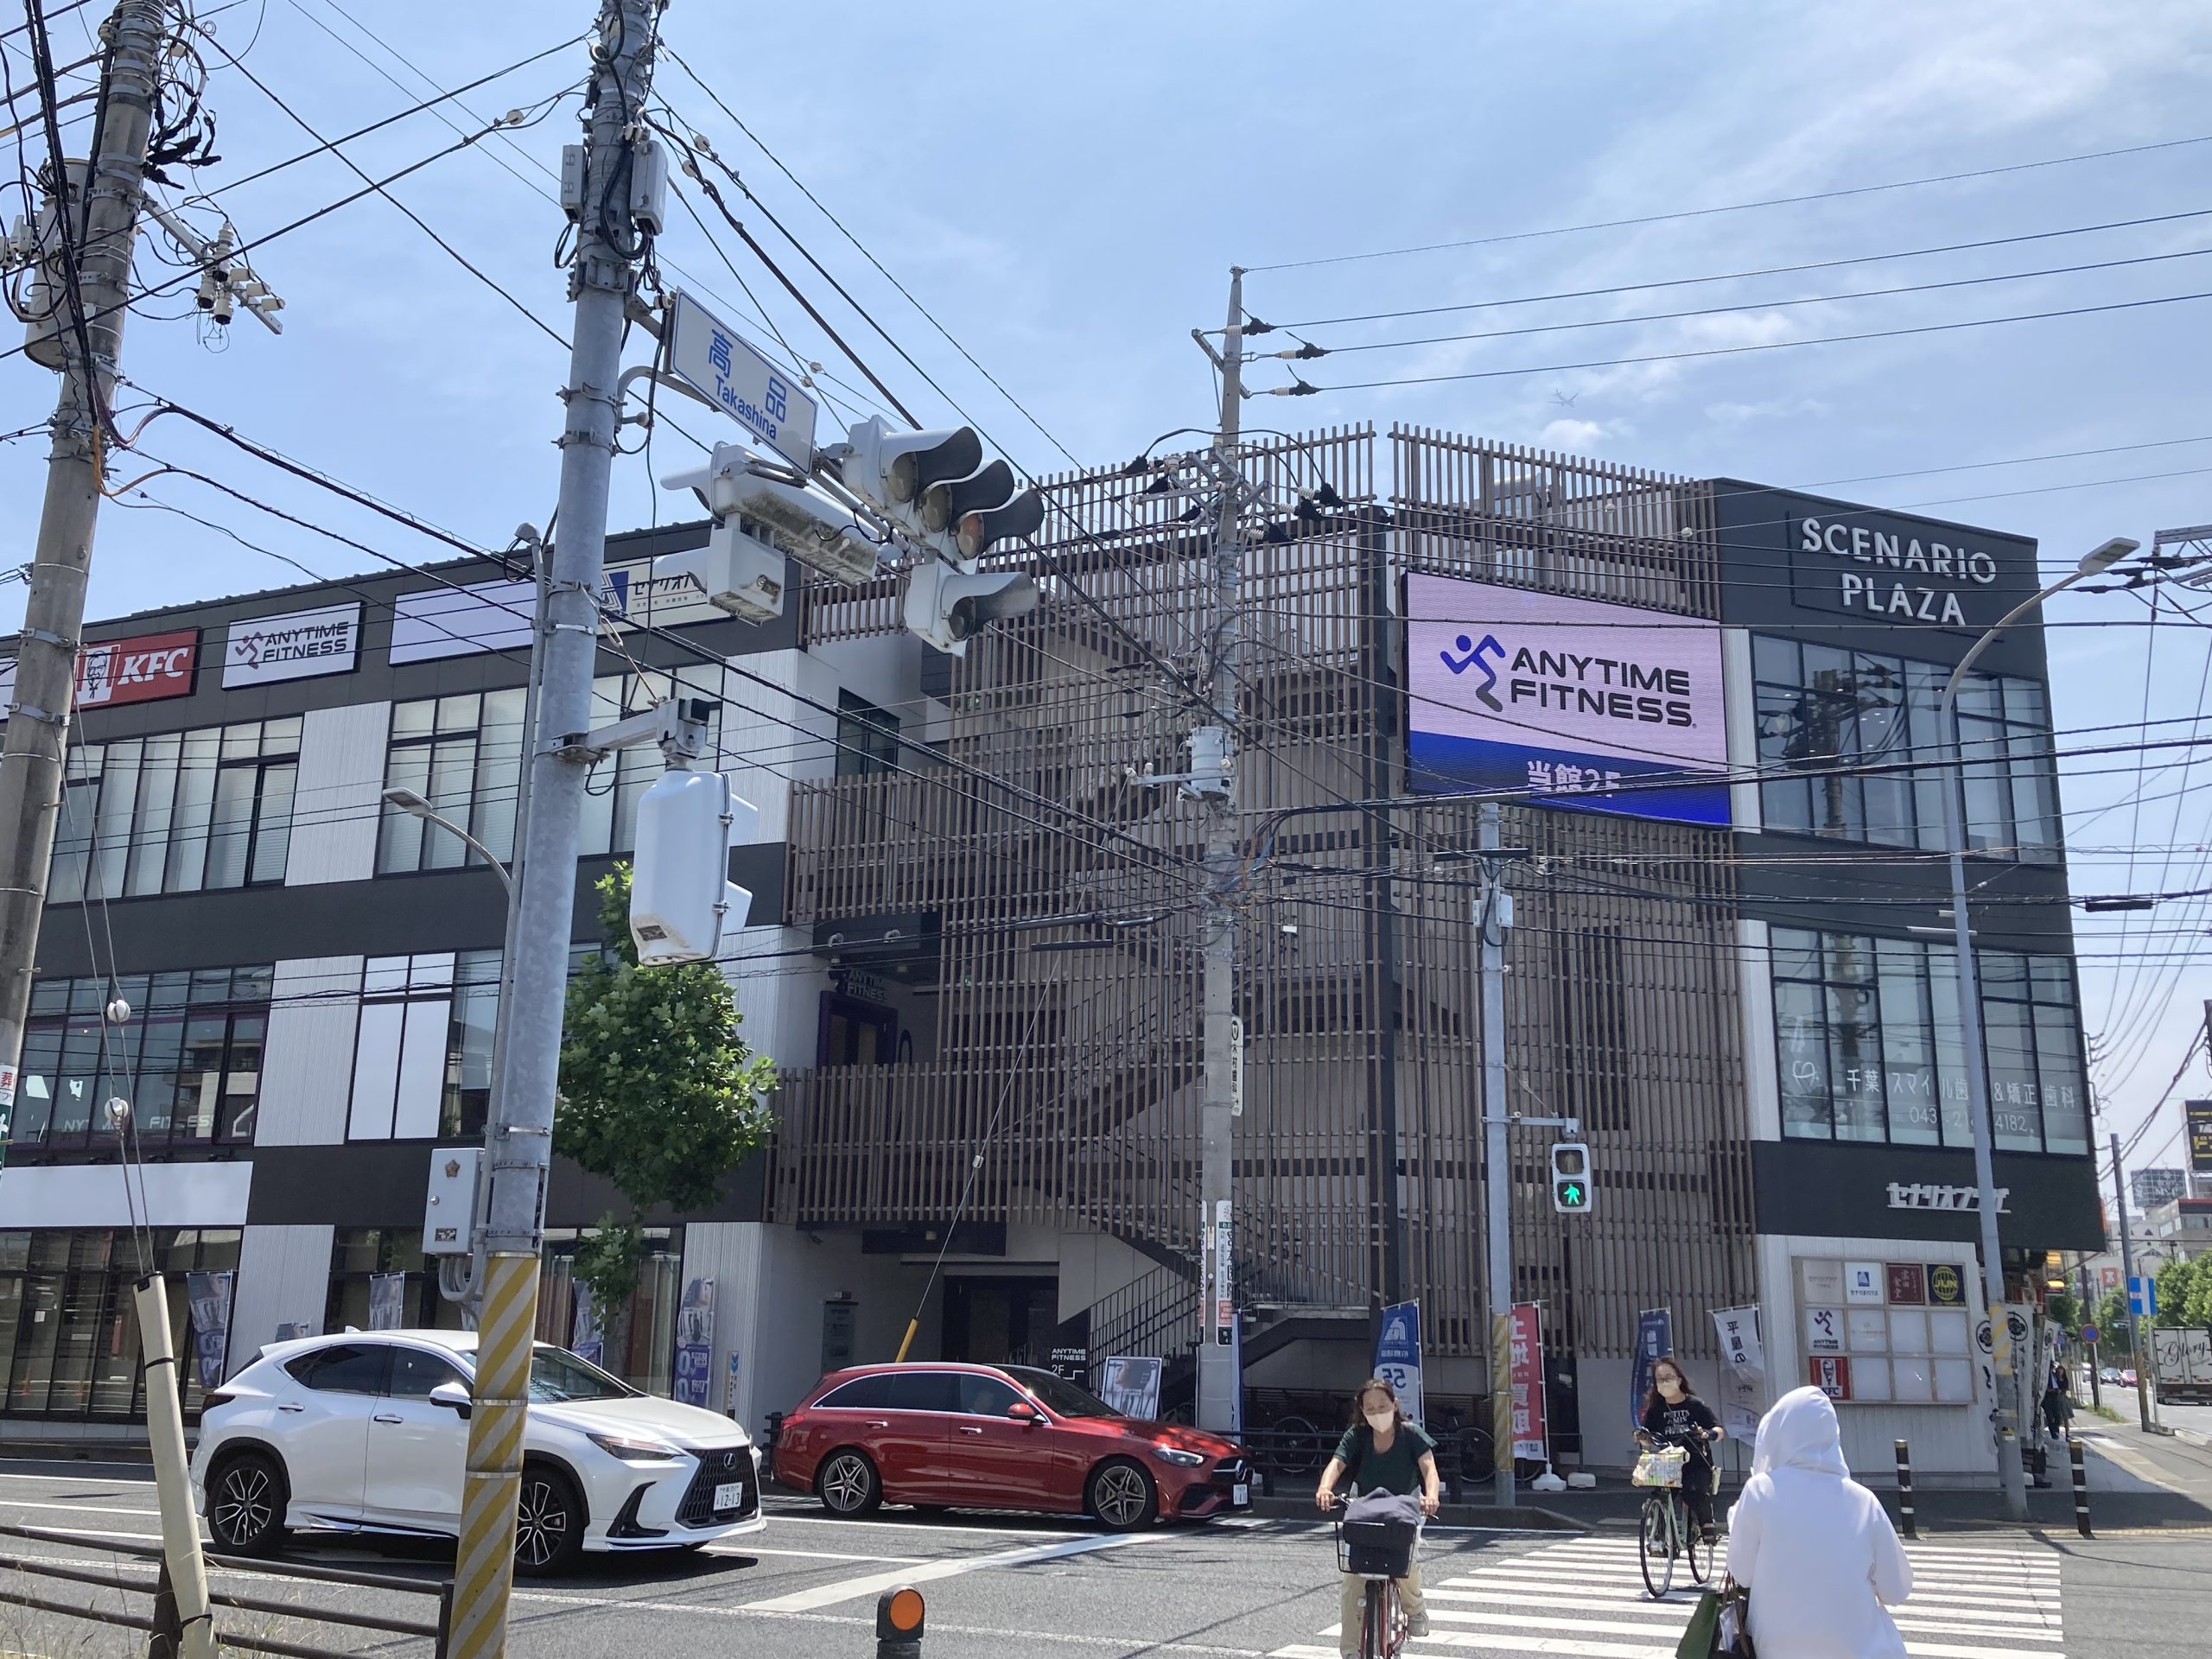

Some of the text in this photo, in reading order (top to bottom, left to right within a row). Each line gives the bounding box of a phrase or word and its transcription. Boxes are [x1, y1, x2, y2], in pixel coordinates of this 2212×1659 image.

[709, 329, 787, 423] 高品
[715, 374, 776, 441] Takashina
[1802, 518, 1997, 584] SCENARIO
[1841, 573, 1966, 626] PLAZA
[262, 639, 347, 663] FITNESS
[264, 621, 349, 647] ANYTIME
[118, 647, 188, 686] KFC
[1511, 646, 1691, 696] ANYTIME
[1510, 678, 1693, 728] FITNESS
[1527, 760, 1622, 798] 当館2F
[1052, 1364, 1065, 1376] 2F
